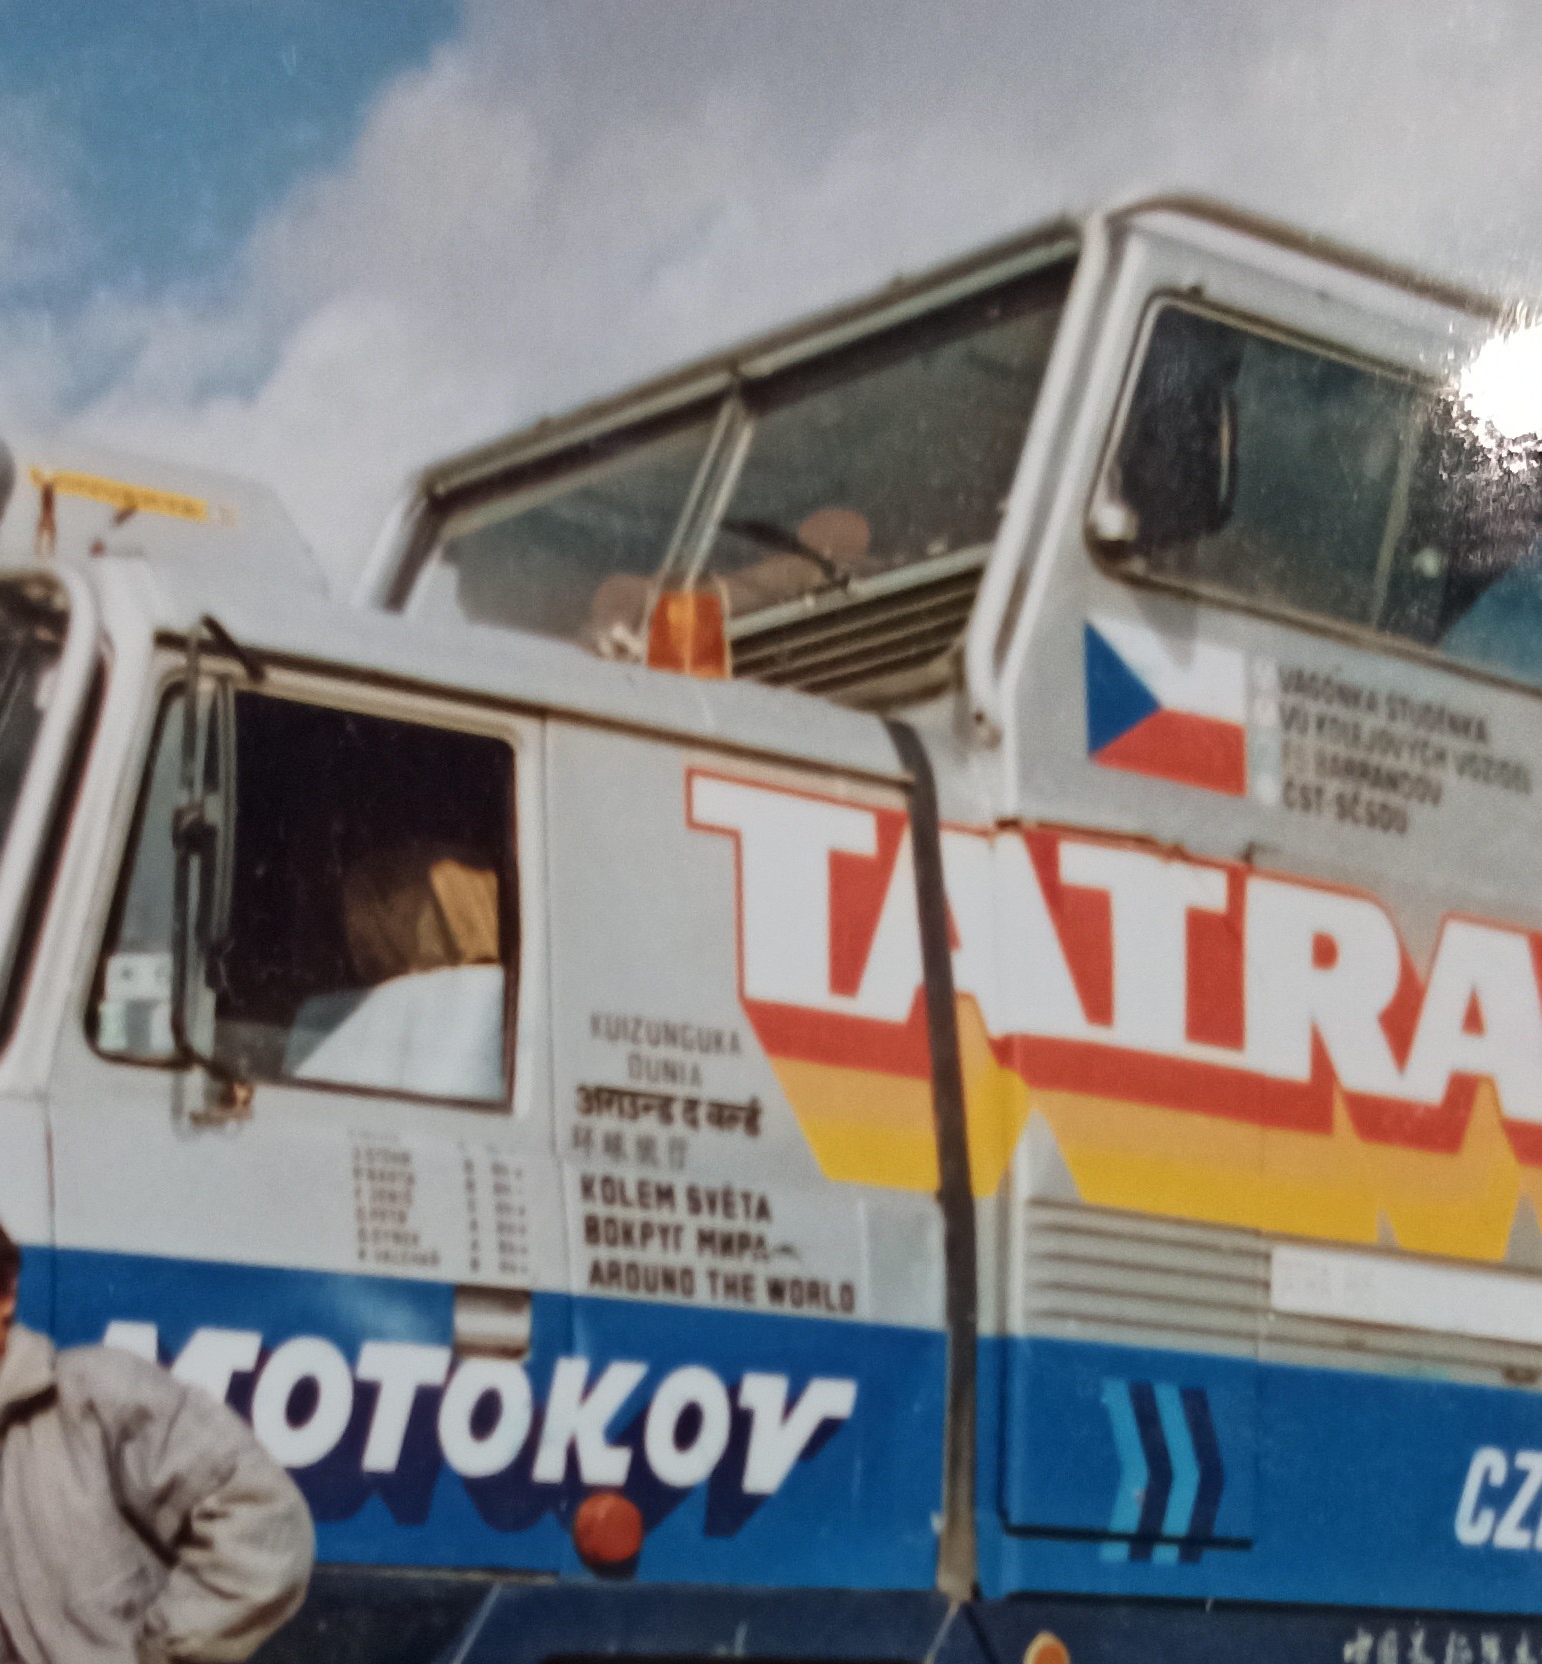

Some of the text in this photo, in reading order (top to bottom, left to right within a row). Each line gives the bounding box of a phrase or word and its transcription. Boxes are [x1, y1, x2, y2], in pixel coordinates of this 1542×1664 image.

[590, 1012, 740, 1054] KUIZUNGUKA
[627, 1053, 702, 1087] DUNIA
[580, 1174, 676, 1214] KOLEM
[584, 1215, 684, 1252] ВОКРУГ
[588, 1258, 856, 1314] AROUND THE WORLD
